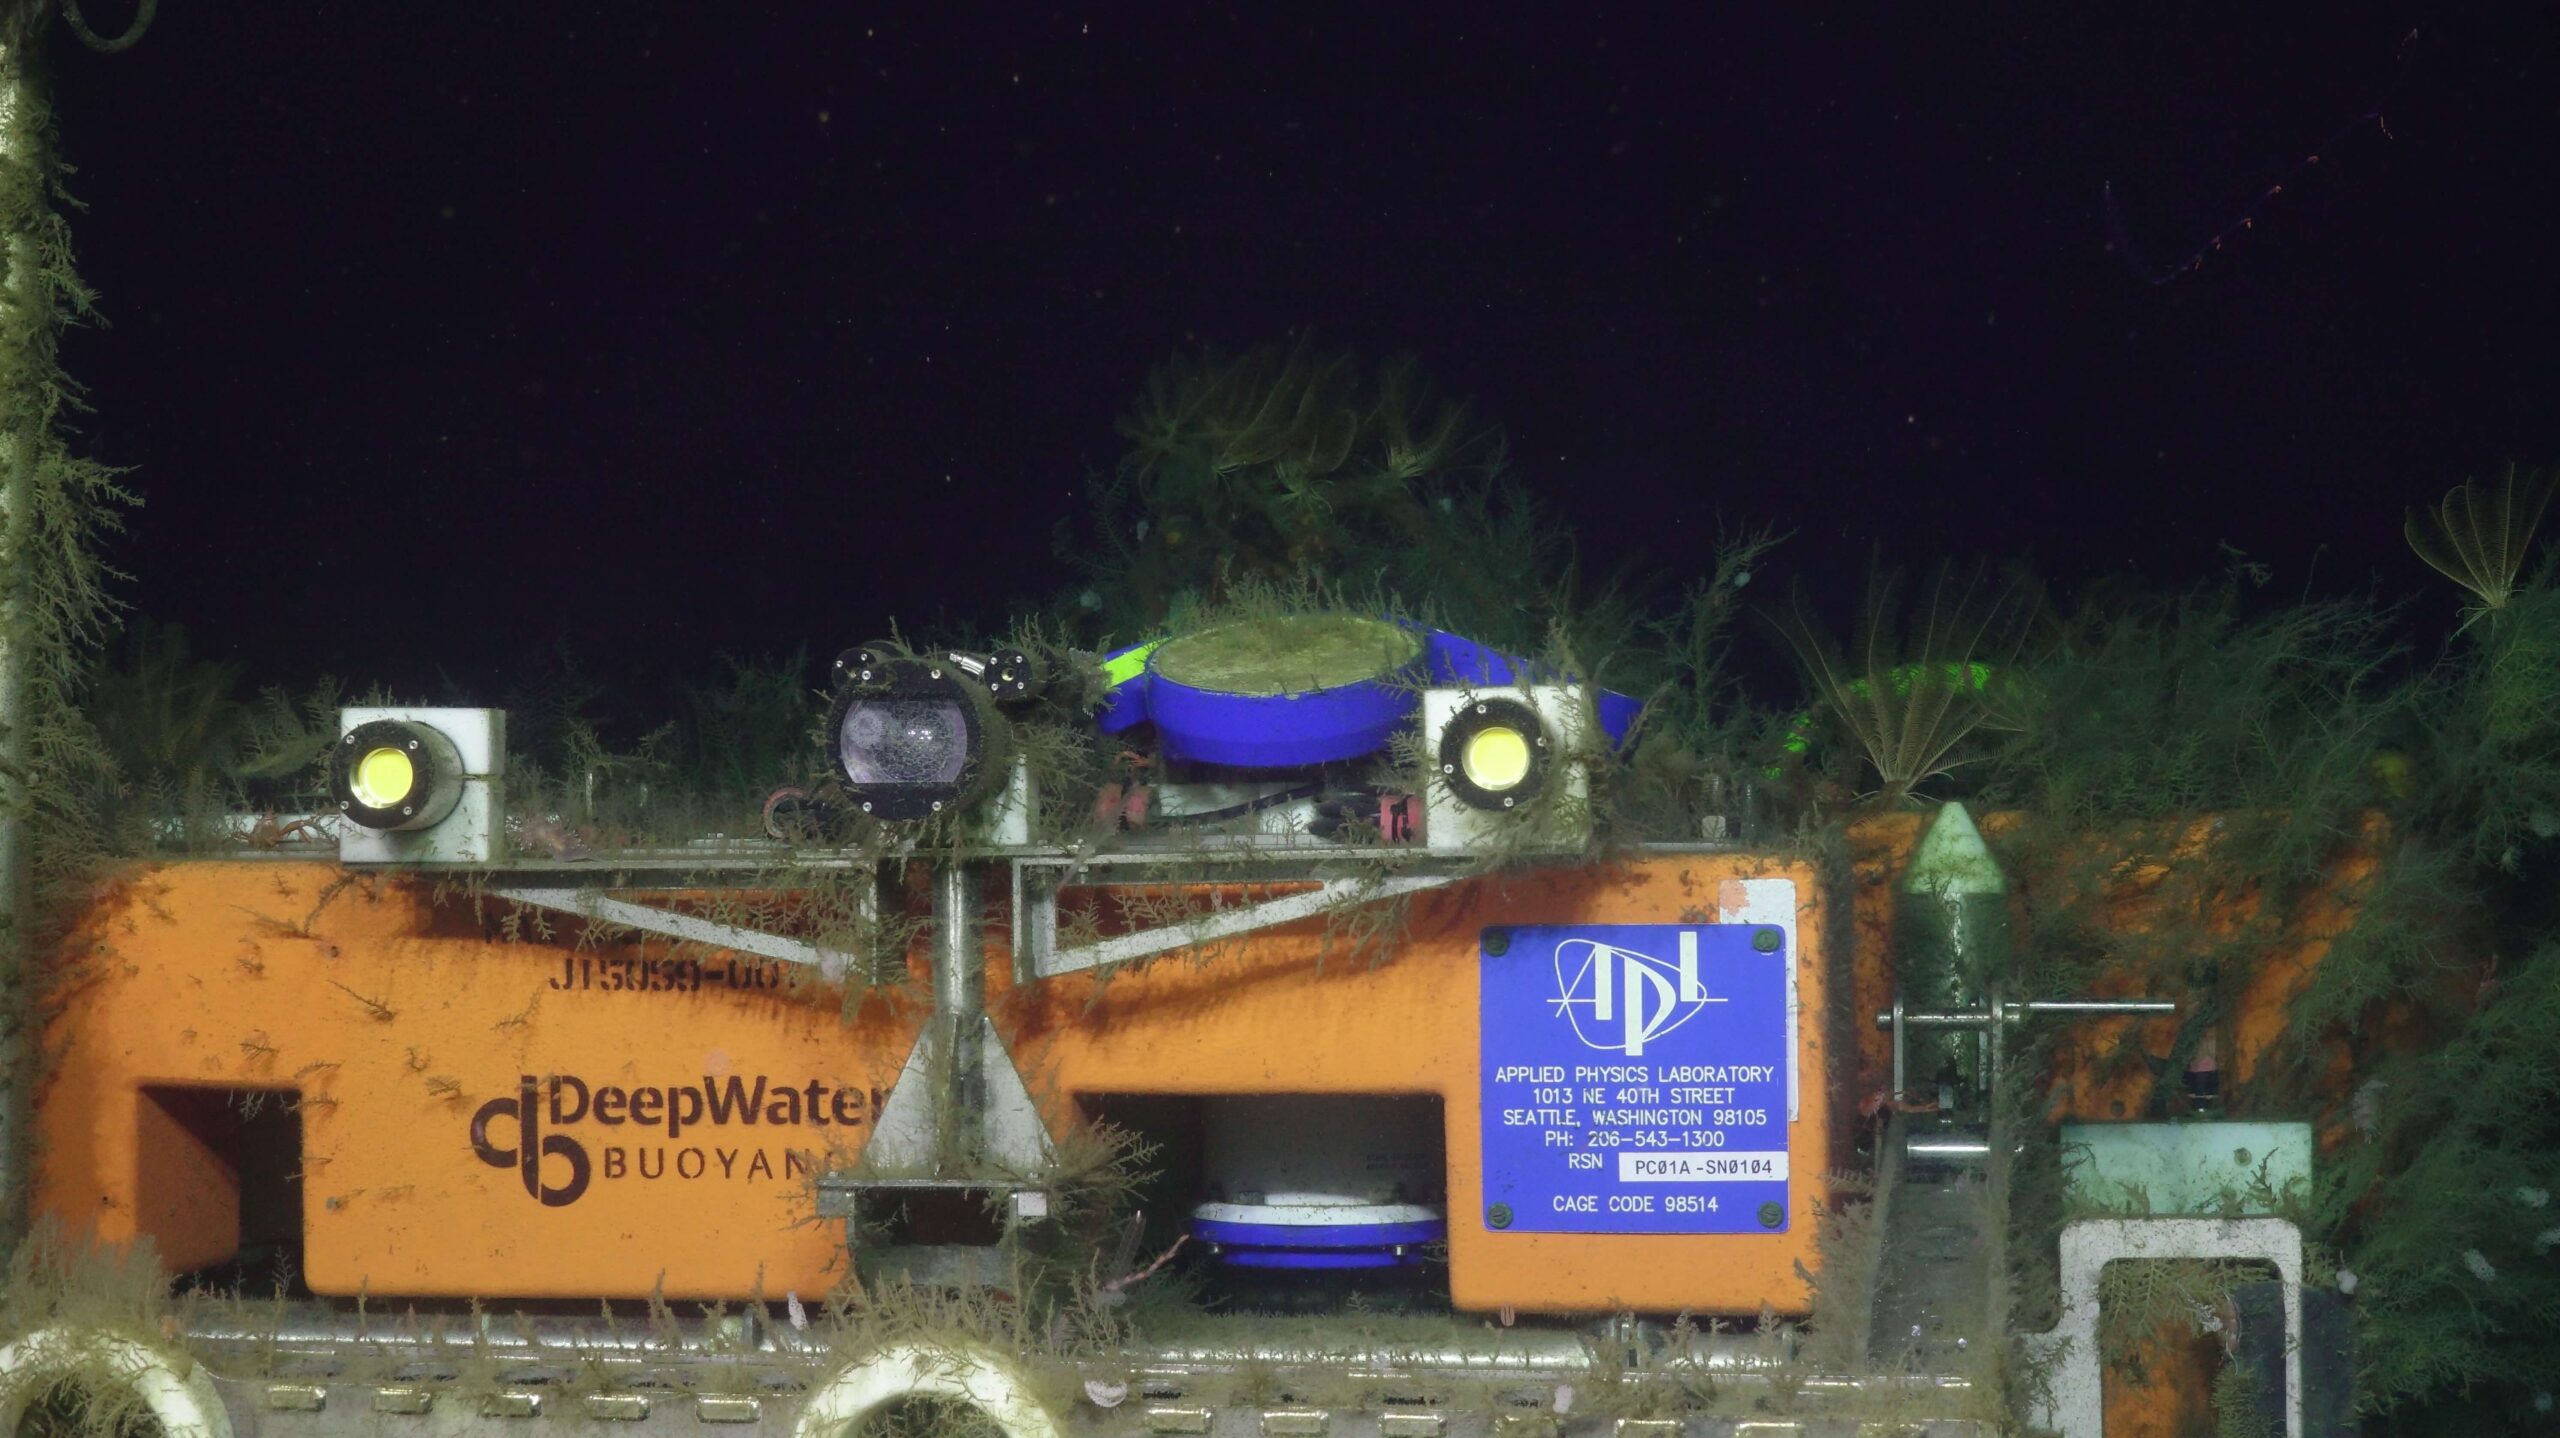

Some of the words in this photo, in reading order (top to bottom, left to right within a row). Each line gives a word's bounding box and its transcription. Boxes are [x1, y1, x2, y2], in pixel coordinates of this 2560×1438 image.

[1547, 932, 1728, 1056] APL
[1495, 1066, 1565, 1082] APPLIED
[1576, 1066, 1648, 1082] PHYSICS
[1659, 1066, 1774, 1082] LABORATORY
[1534, 1088, 1572, 1104] 1013
[1583, 1088, 1605, 1104] NE
[1616, 1088, 1659, 1103] 40TH
[1671, 1088, 1735, 1104] STREET
[550, 1075, 890, 1139] DeepWater
[1504, 1109, 1580, 1127] SEATTLE,
[1593, 1109, 1701, 1125] WASHINGTON
[1714, 1109, 1766, 1125] 98105
[1546, 1131, 1573, 1146] PH:
[1588, 1131, 1724, 1147] 206-543-1300
[1569, 1153, 1602, 1169] RSN
[1553, 1196, 1598, 1211] CAGE
[1609, 1196, 1654, 1212] CODE
[1665, 1196, 1718, 1212] 98514
